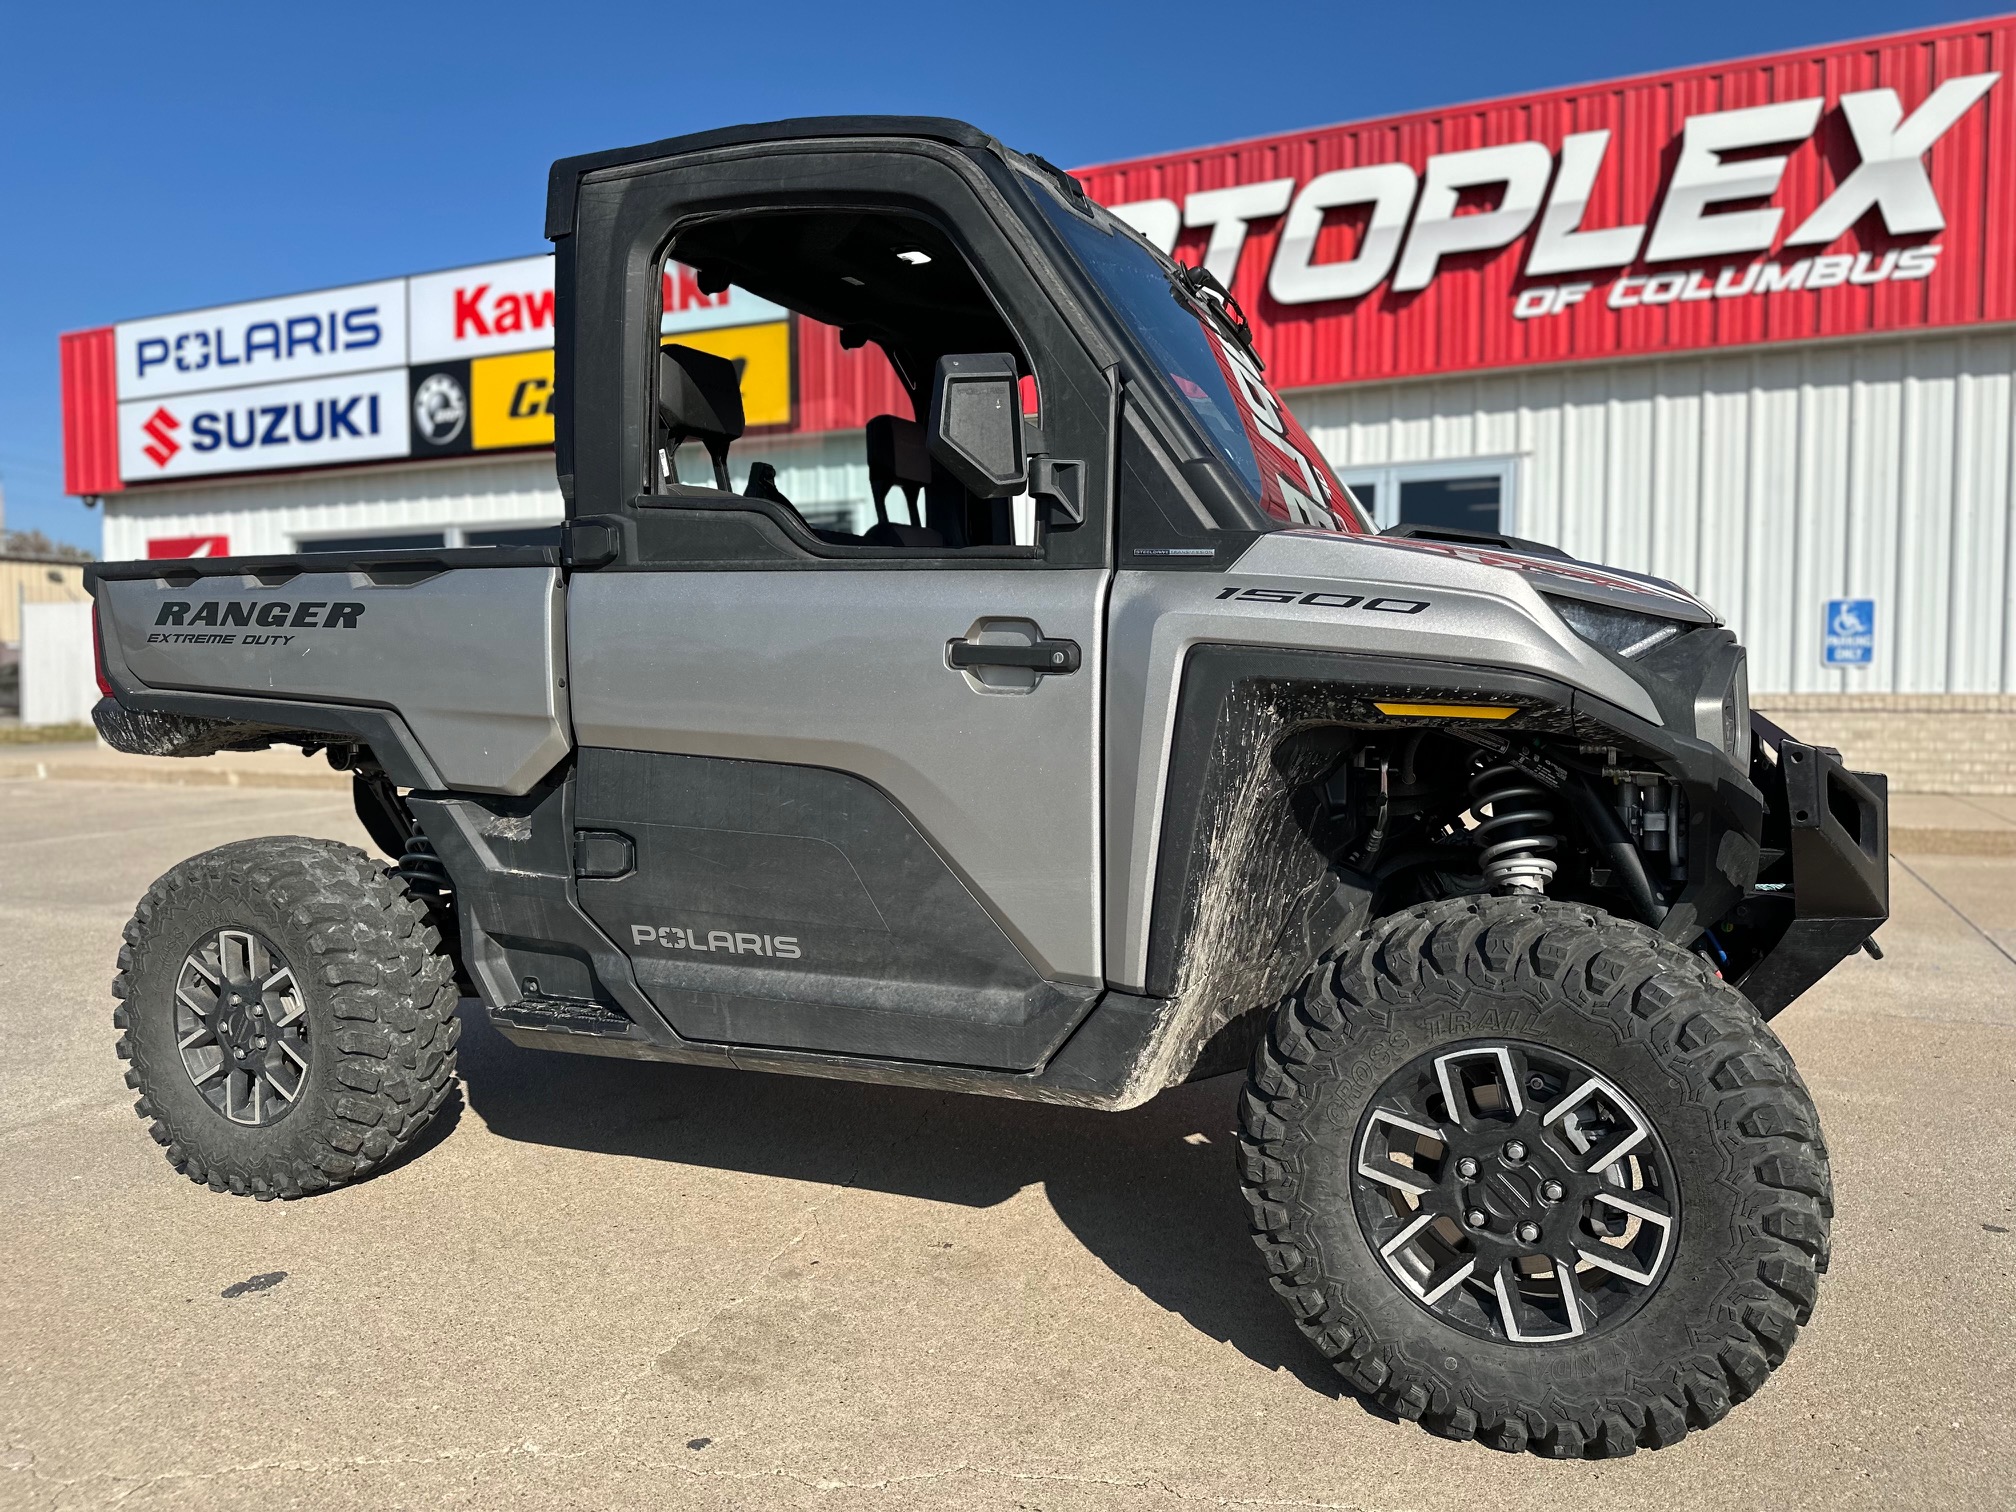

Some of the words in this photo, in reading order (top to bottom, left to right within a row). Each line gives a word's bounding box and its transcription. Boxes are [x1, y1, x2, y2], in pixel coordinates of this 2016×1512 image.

[1513, 283, 1592, 320] OF
[1607, 245, 1944, 310] COLUMBUS
[136, 305, 382, 379] POLARIS
[191, 393, 380, 453] SUZUKI
[154, 601, 366, 629] RANGER
[1215, 587, 1431, 614] 1500
[147, 633, 236, 645] EXTREME
[241, 634, 295, 646] DUTY
[1834, 648, 1864, 661] ONLY
[185, 908, 239, 930] TRAIL
[631, 924, 802, 959] POLARIS
[1326, 1029, 1411, 1127] CROSS
[1424, 1008, 1548, 1038] TRAIL
